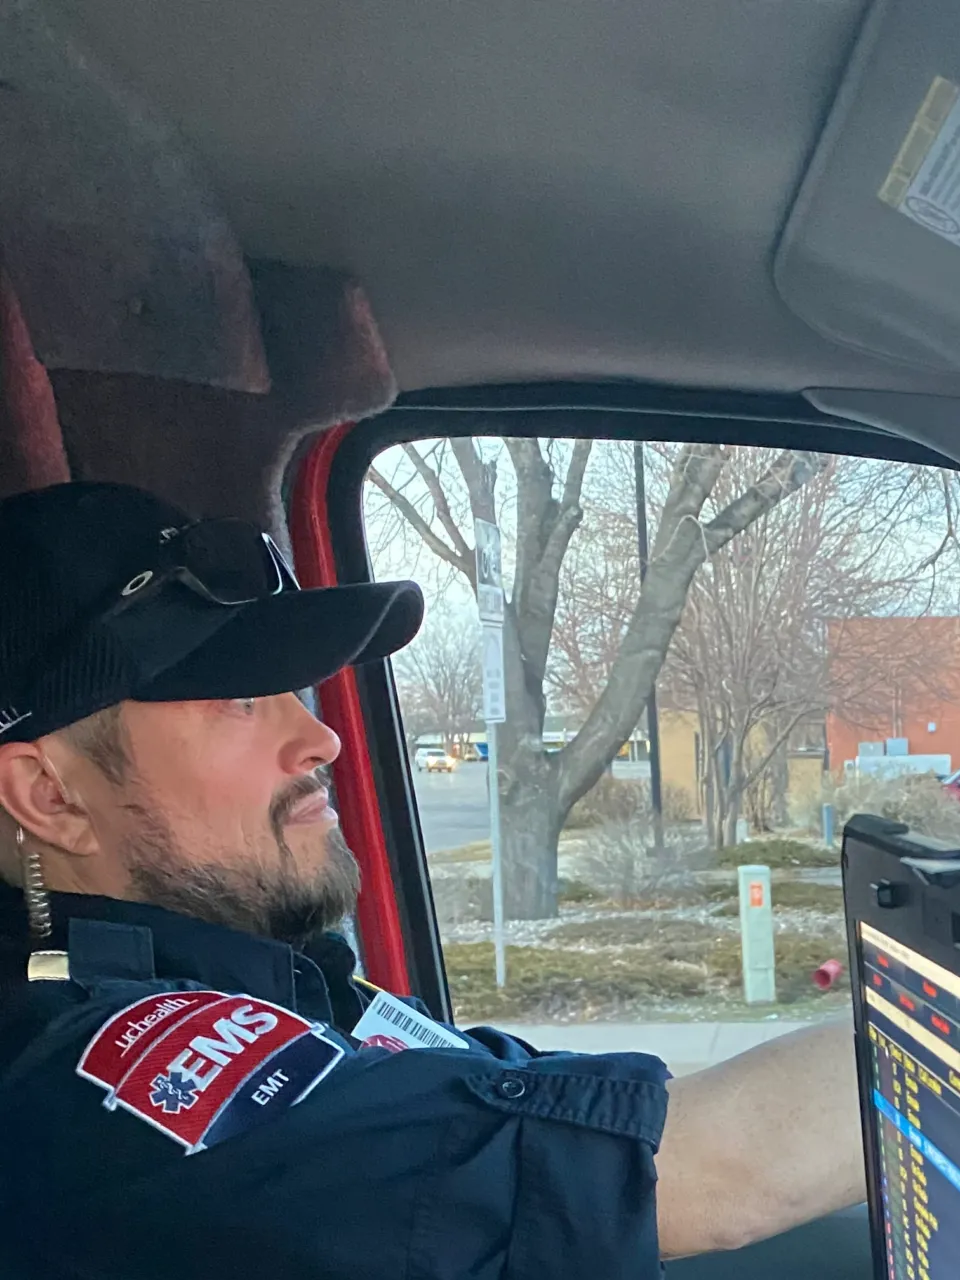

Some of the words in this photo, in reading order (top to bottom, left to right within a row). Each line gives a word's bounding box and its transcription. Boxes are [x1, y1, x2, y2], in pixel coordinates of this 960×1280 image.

[115, 997, 191, 1050] uchealth
[167, 1004, 278, 1092] EMS
[251, 1068, 290, 1105] EMT
